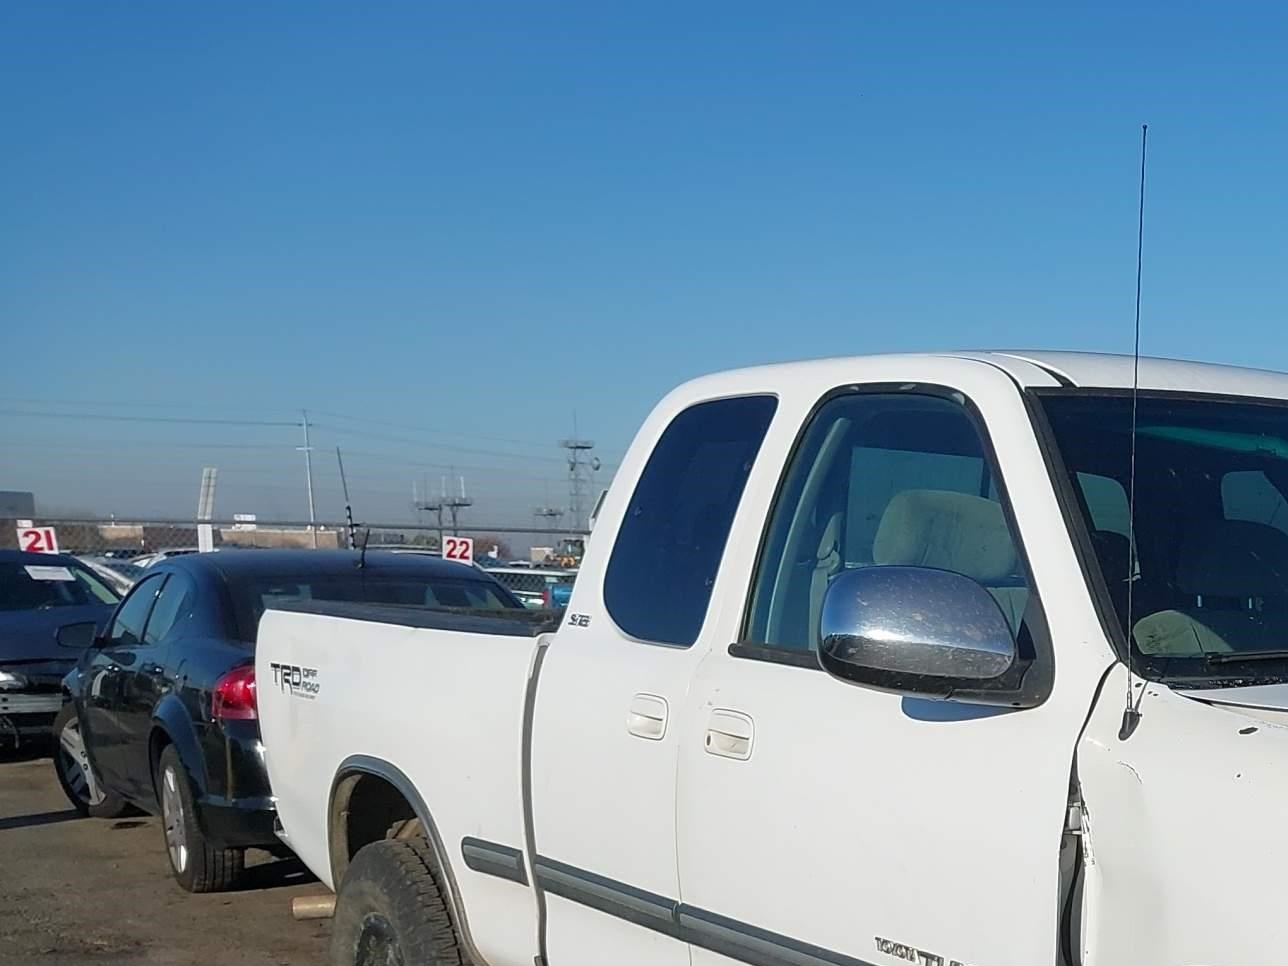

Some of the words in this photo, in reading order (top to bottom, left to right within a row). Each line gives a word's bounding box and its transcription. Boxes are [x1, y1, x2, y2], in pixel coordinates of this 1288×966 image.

[22, 529, 54, 553] 21
[445, 538, 470, 561] 22
[270, 662, 302, 695] TRD
[302, 667, 318, 679] OFF
[301, 680, 320, 694] ROAD
[874, 936, 921, 965] TOYOTA
